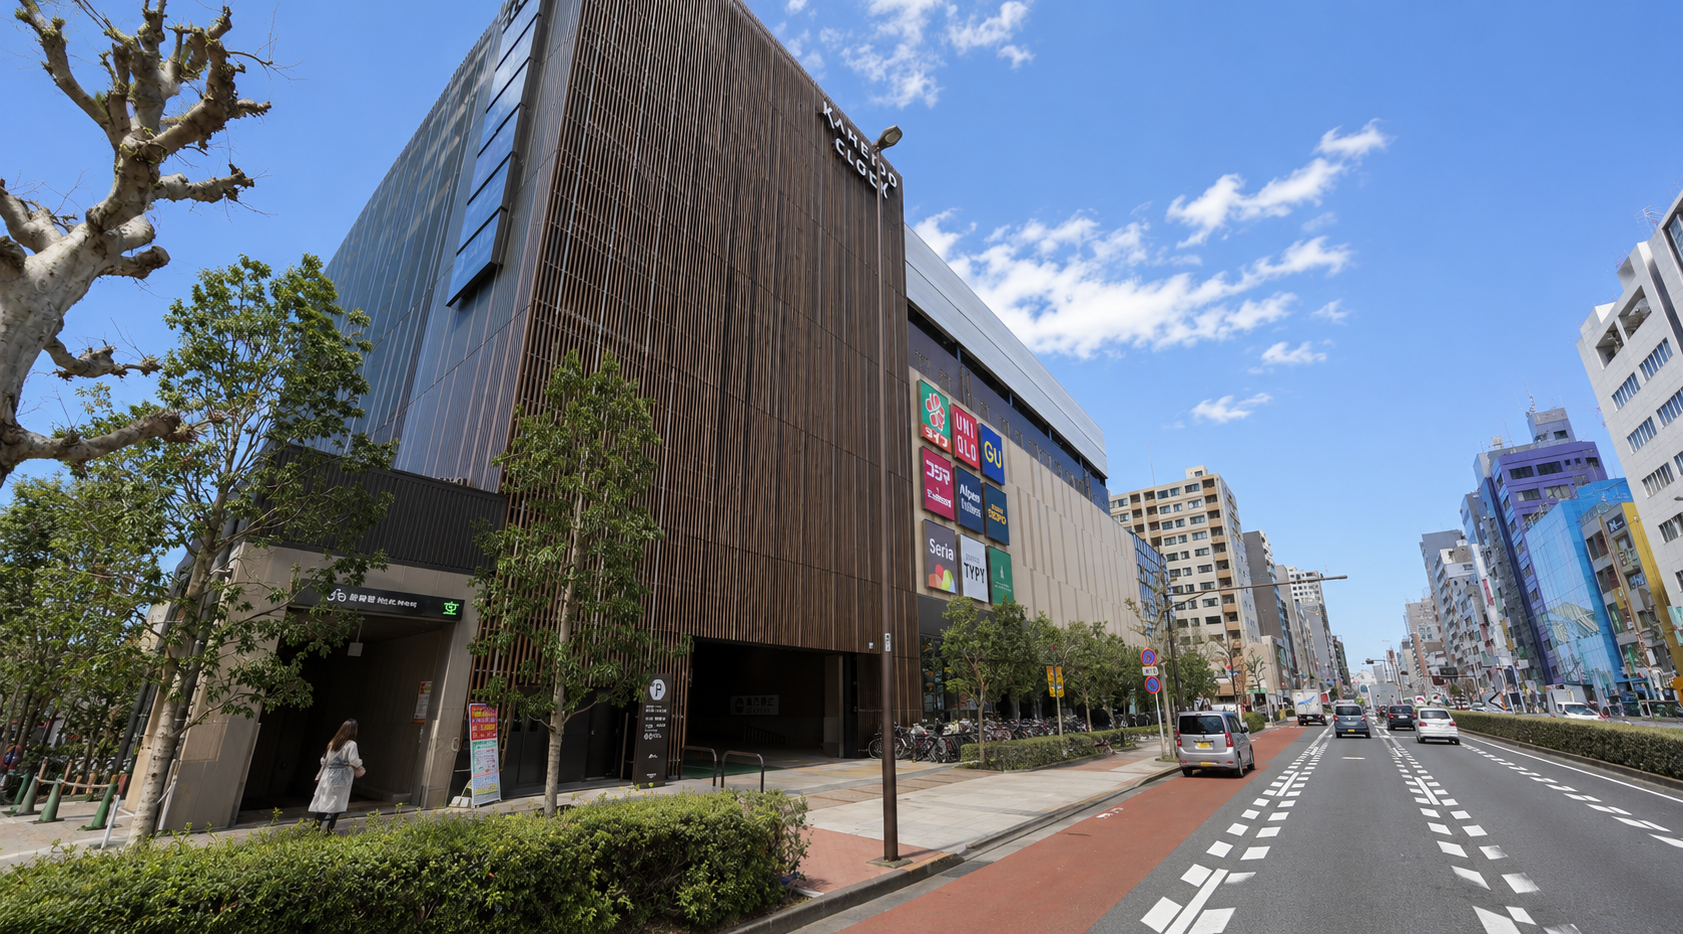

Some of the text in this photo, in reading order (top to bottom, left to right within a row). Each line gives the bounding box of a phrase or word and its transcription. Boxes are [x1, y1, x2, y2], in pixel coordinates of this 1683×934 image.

[984, 441, 1002, 469] GU
[926, 459, 950, 485] コジマ
[929, 538, 954, 561] Seria
[963, 562, 985, 584] TYPY
